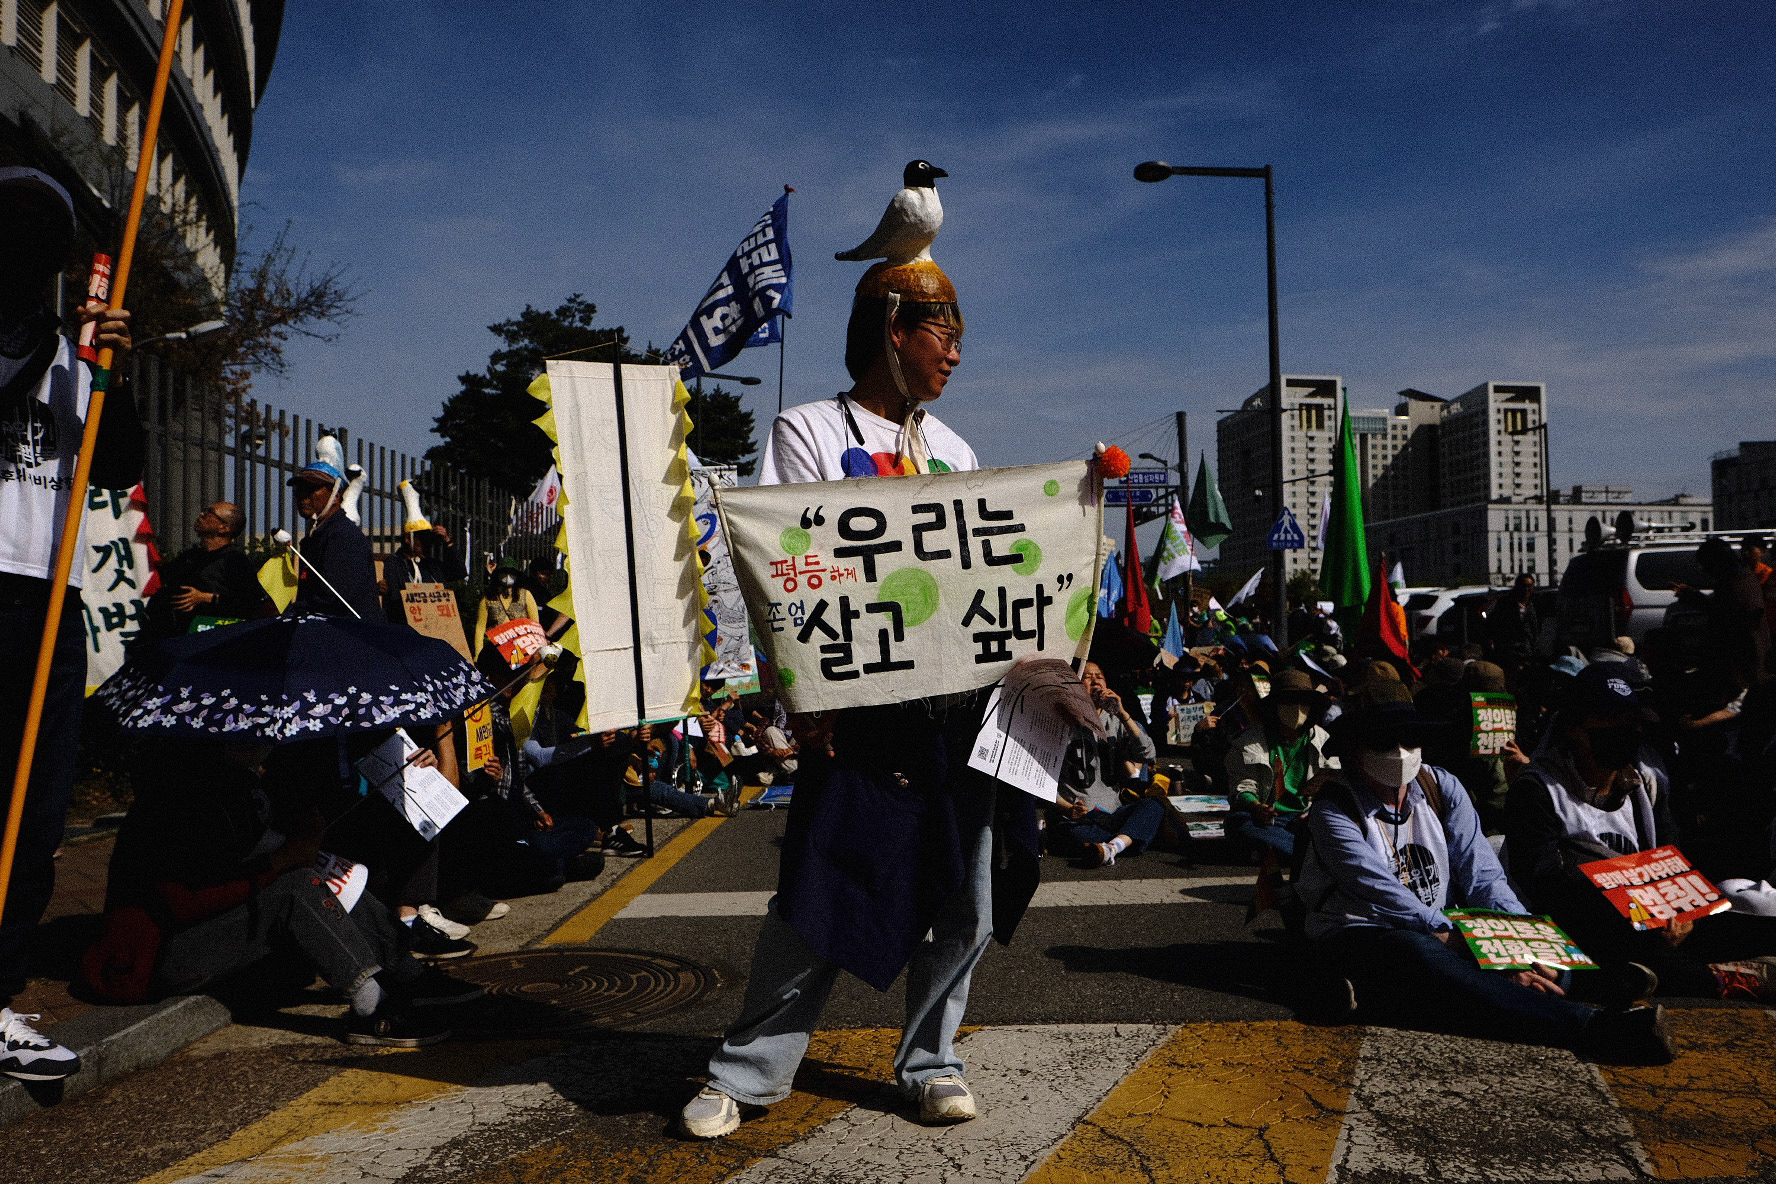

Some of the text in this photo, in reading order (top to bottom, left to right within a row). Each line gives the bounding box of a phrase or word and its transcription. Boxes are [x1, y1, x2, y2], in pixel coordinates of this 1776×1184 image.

[800, 497, 1027, 583] “우리는
[769, 554, 858, 593] 평등하게
[409, 605, 424, 623] 안
[797, 572, 1074, 682] 살고 싶다”
[1626, 874, 1720, 920] 멈춰!
[1460, 918, 1567, 944] 정의로운
[1475, 937, 1572, 964] 전환을!
